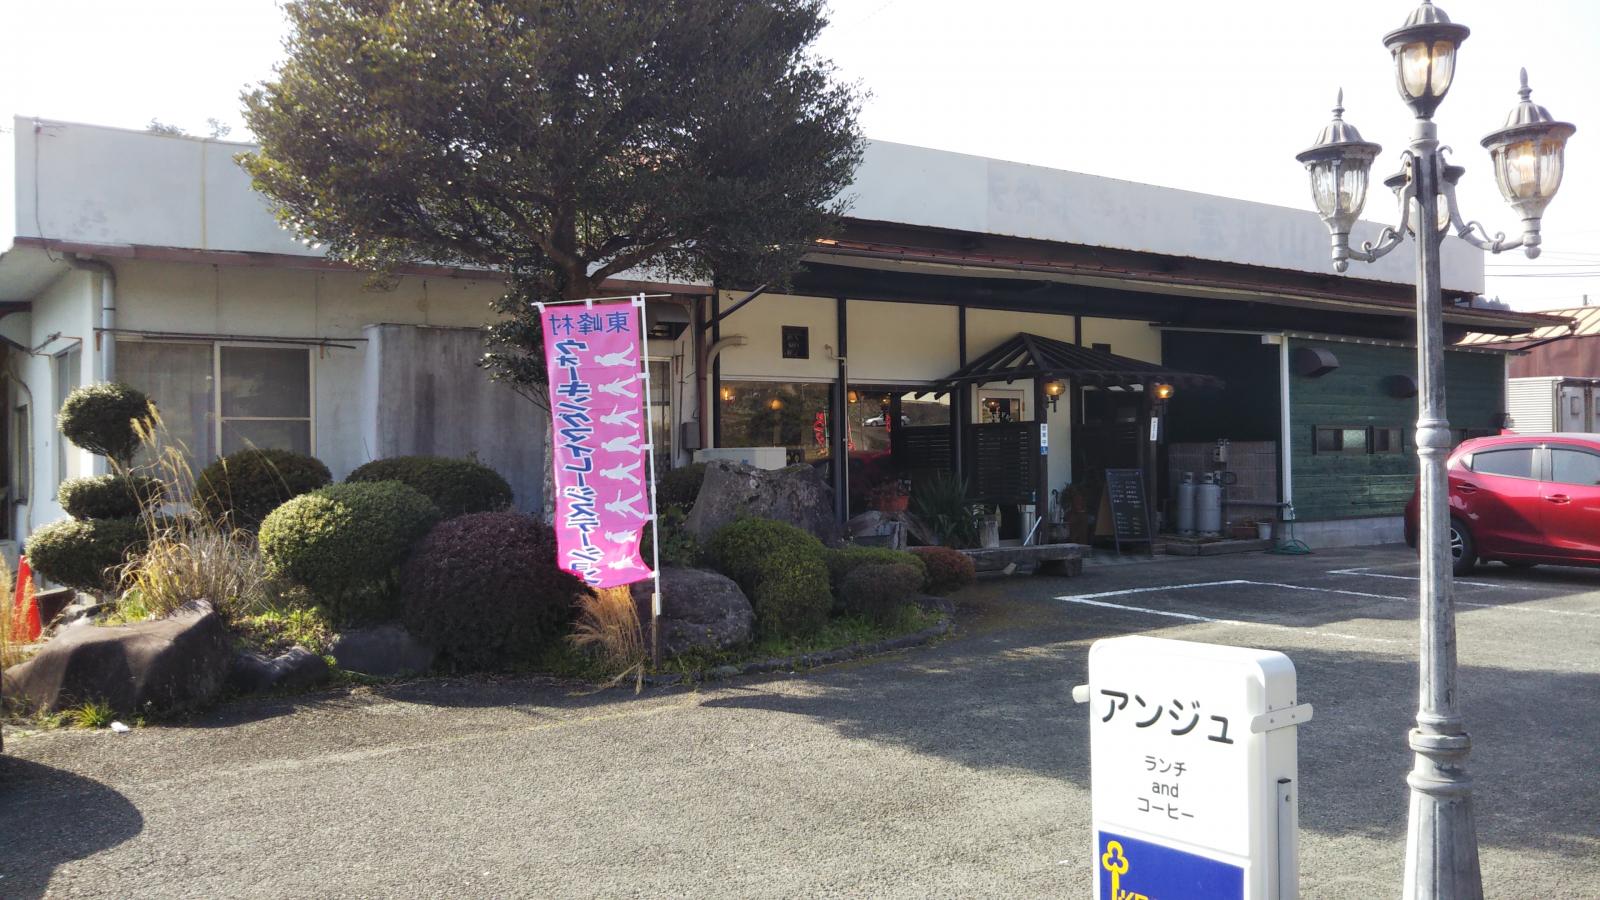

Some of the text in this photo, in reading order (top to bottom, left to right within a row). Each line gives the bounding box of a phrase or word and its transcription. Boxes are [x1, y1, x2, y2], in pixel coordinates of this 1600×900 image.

[1100, 689, 1234, 744] アンジュ
[1144, 755, 1187, 777] ランチ
[1151, 781, 1179, 798] and
[1137, 797, 1194, 820] コーヒー
